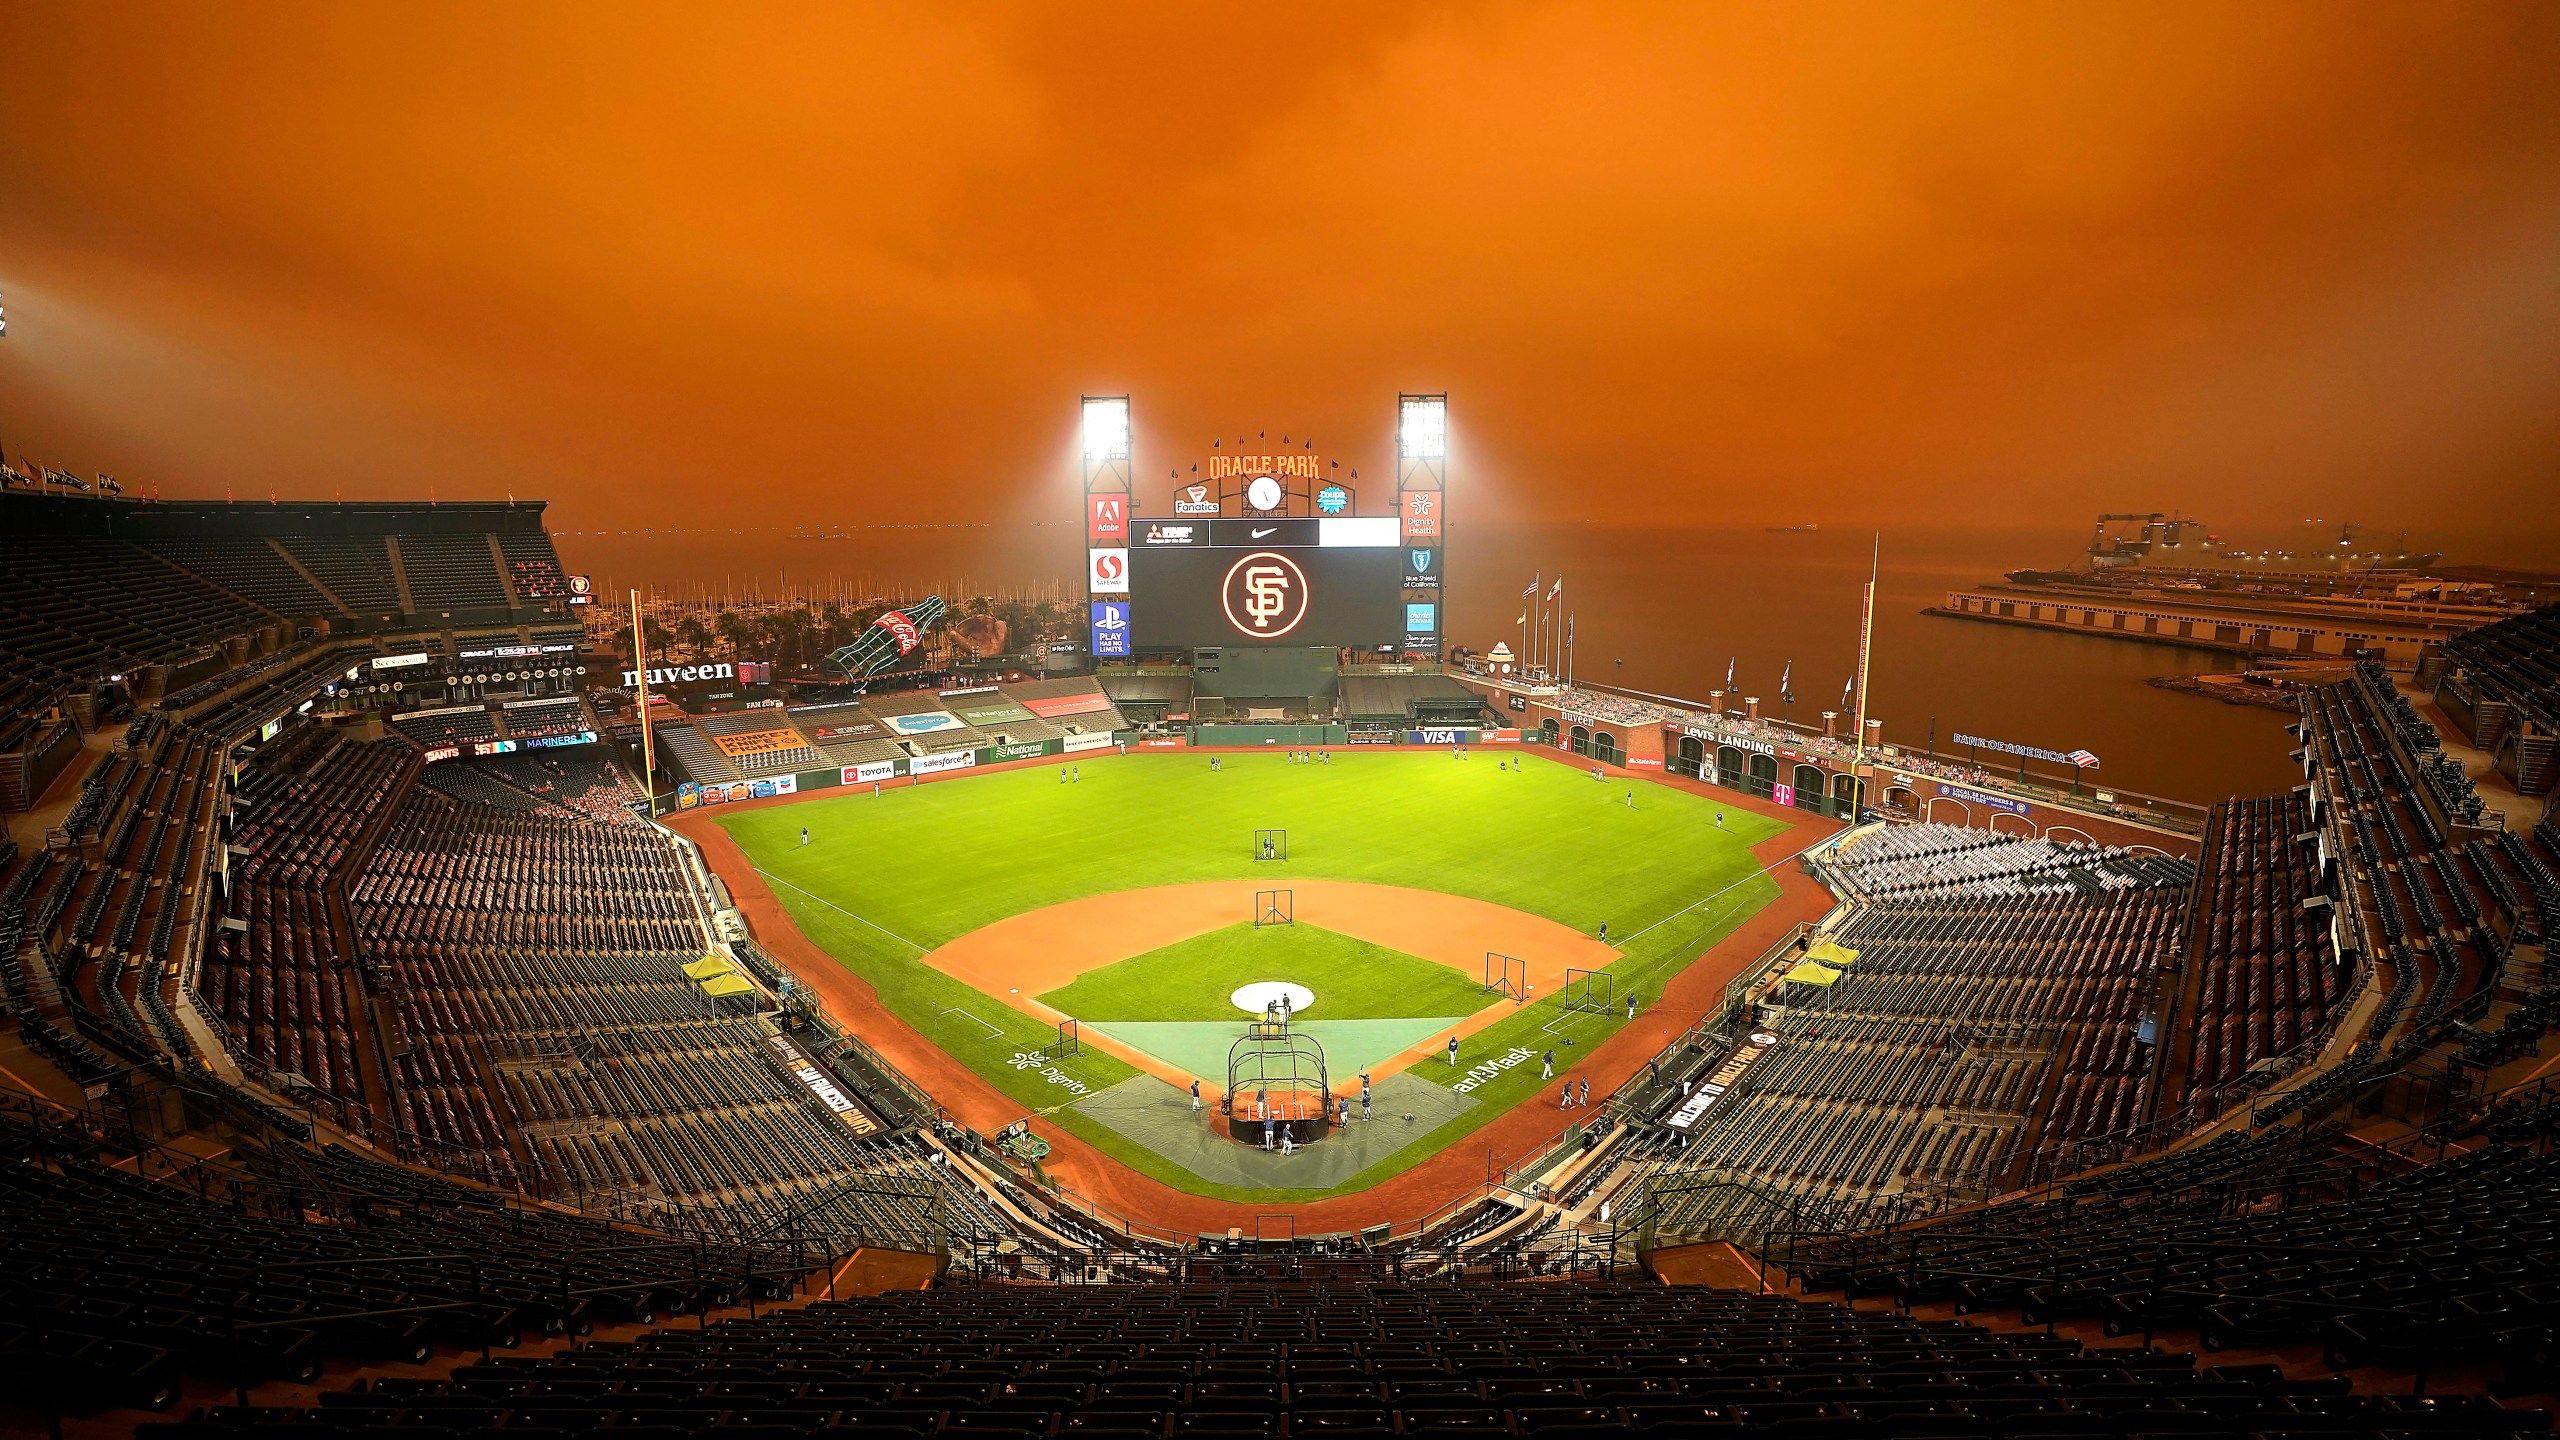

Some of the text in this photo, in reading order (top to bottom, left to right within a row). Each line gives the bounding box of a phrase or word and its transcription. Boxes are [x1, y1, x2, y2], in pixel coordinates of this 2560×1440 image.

[1209, 455, 1320, 480] ORACLE PARK
[1177, 502, 1218, 512] Fanatics
[1097, 523, 1120, 532] Adobe
[1407, 517, 1435, 526] Dignity
[460, 650, 494, 658] ORACLE
[542, 645, 574, 653] ORACLE
[904, 718, 946, 726] salesforce
[1561, 711, 1594, 727] nuveen
[720, 731, 790, 743] MONKEY
[725, 737, 776, 748] KNIFE
[1421, 732, 1456, 743] VISA
[425, 747, 459, 762] GIANTS
[527, 735, 577, 748] MARINERS
[728, 743, 779, 753] FIGHT
[1006, 742, 1043, 756] National
[1717, 733, 1775, 755] LANDING
[1953, 733, 2065, 763] BANK OF AMERICA
[923, 755, 962, 769] salesforce
[861, 766, 892, 778] TOYOTA
[1980, 794, 2009, 804] PLUMBERS
[1039, 1067, 1092, 1095] Dignity
[1666, 1045, 1763, 1128] WELCOME TO ORACLE PARK
[796, 1066, 878, 1135] SAN FRANCISCO GIANTS
